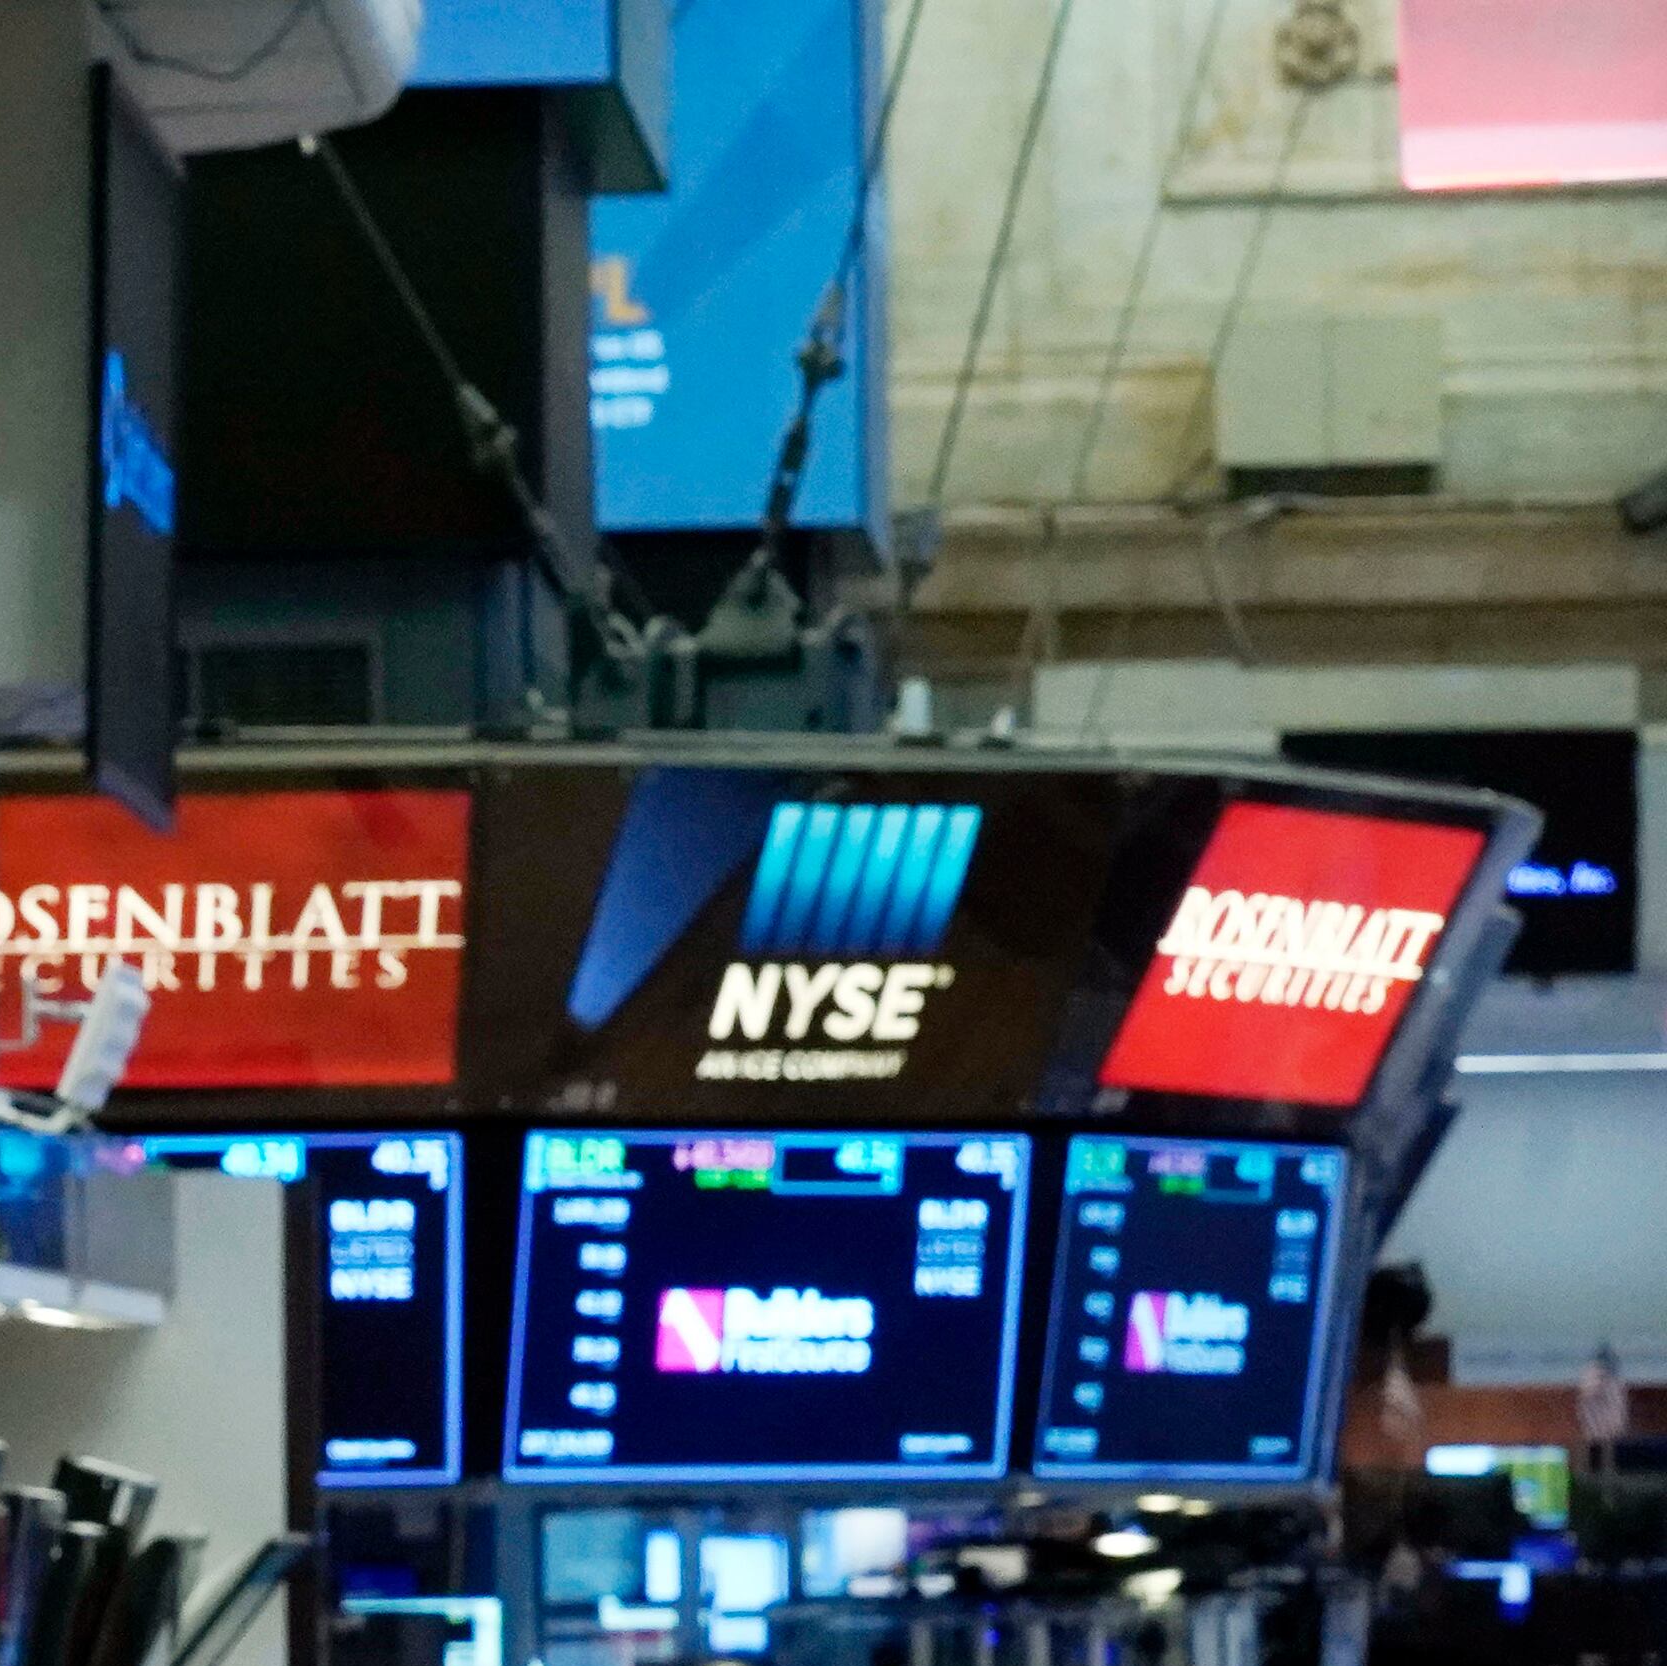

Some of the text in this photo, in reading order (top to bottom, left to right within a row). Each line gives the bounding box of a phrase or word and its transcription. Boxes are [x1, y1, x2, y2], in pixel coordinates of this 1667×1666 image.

[1157, 885, 1445, 978] ROSENBLATT
[708, 962, 937, 1041] NYSE
[1163, 952, 1394, 1015] SECURITIES
